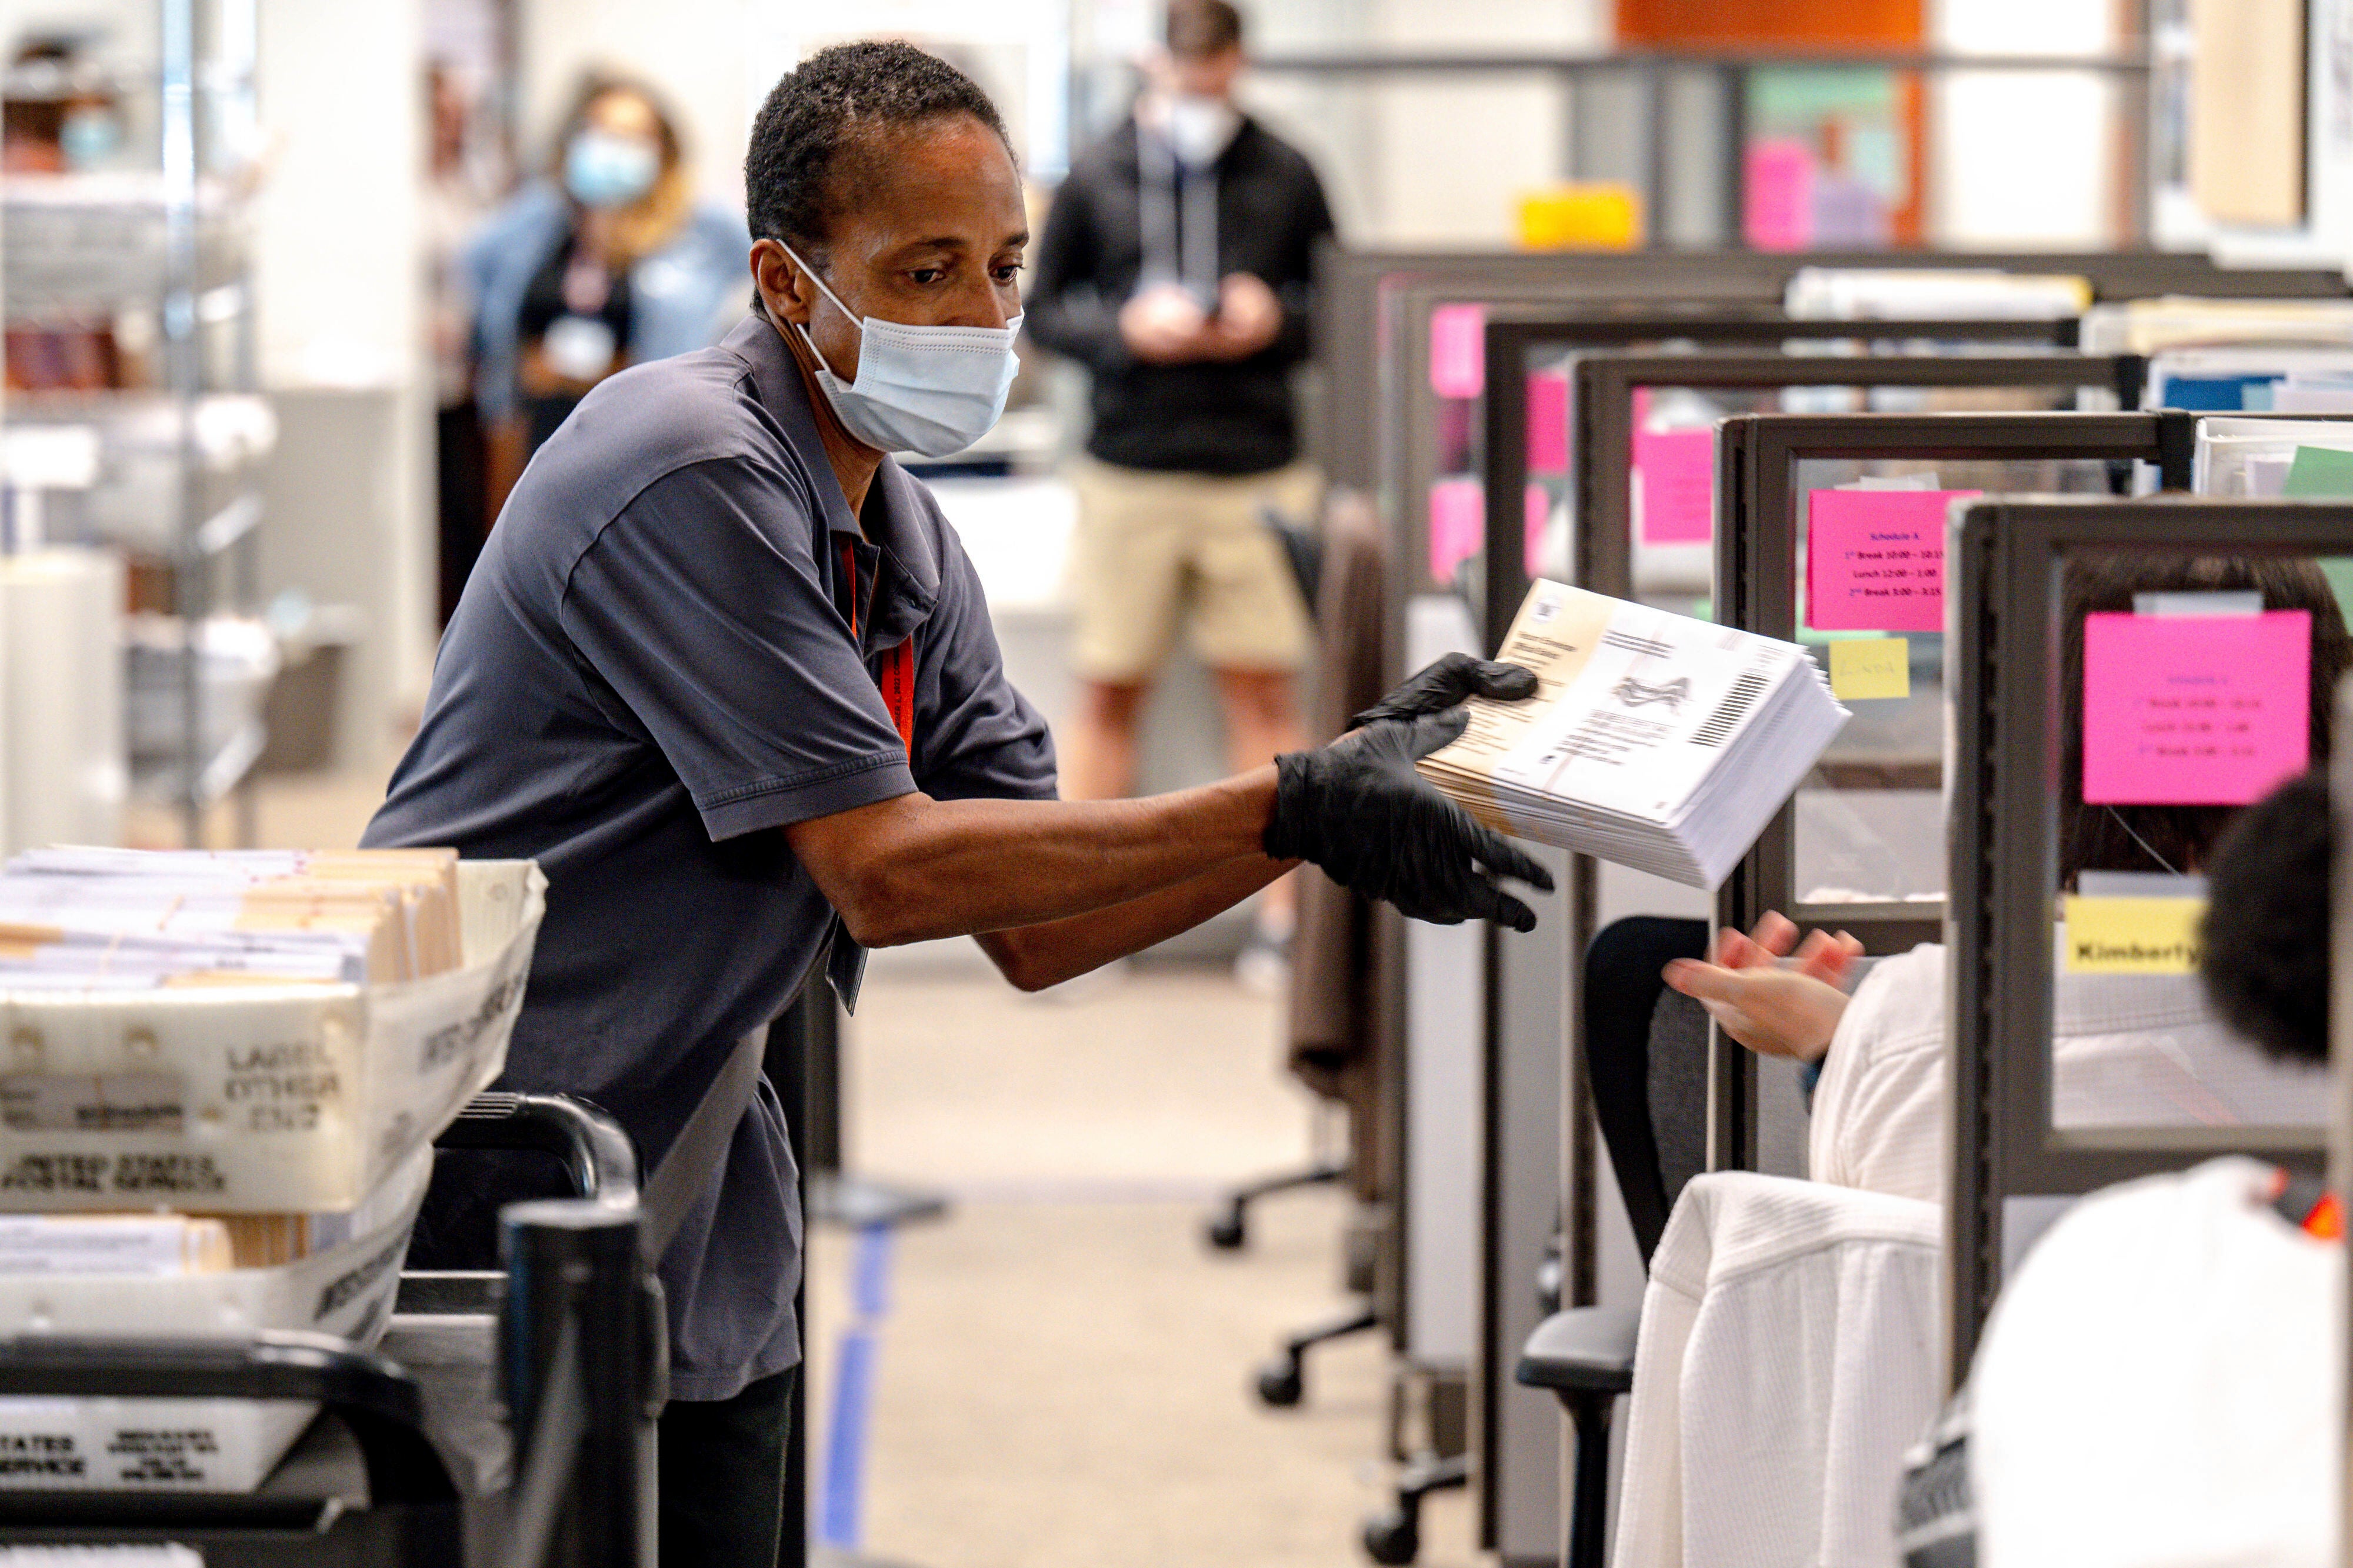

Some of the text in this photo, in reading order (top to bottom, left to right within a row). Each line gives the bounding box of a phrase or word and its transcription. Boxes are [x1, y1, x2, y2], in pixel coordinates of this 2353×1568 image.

[1870, 532, 1910, 541] Schedule
[1857, 551, 1882, 559] Break
[1853, 569, 1880, 578] Lunch
[1864, 588, 1889, 596] Break
